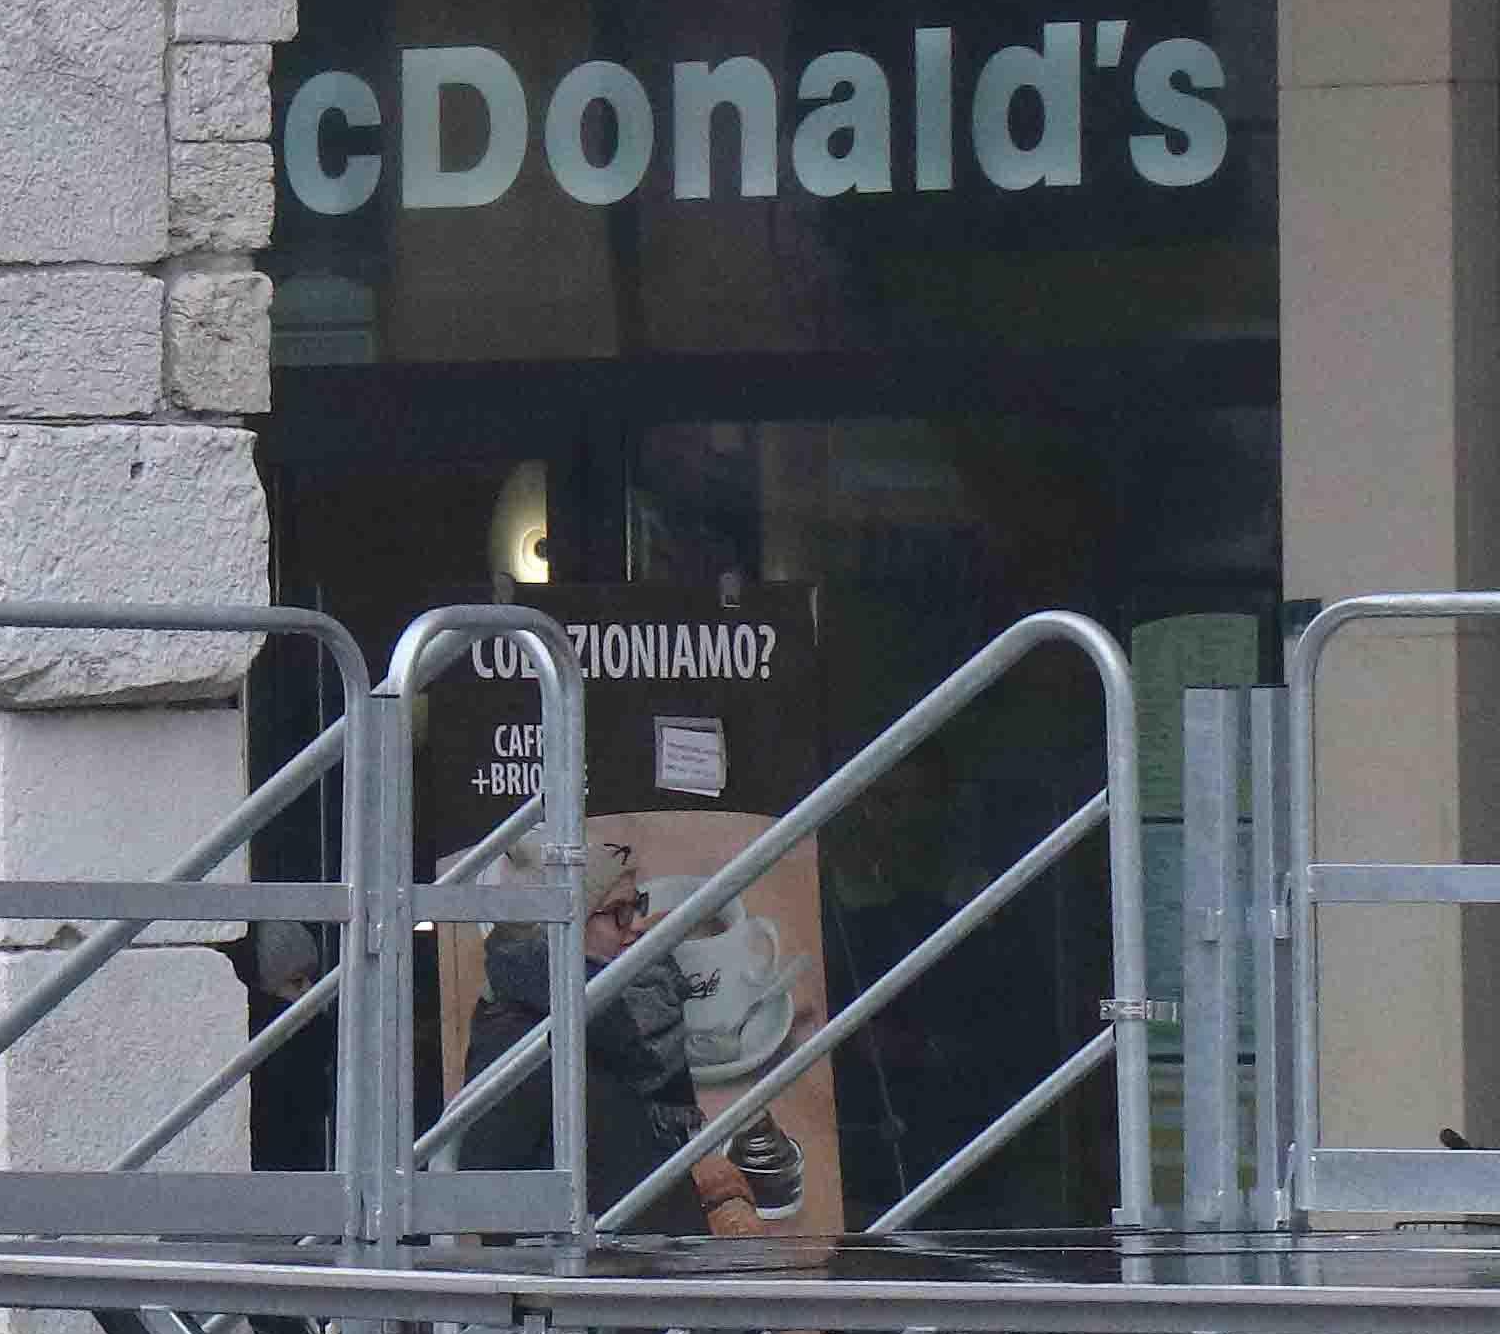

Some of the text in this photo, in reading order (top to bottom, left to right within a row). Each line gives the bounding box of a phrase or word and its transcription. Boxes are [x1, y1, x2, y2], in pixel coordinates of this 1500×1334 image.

[284, 19, 1228, 216] cDonald's
[472, 623, 777, 680] COLZIONIAMO?
[493, 723, 545, 758] CAFF
